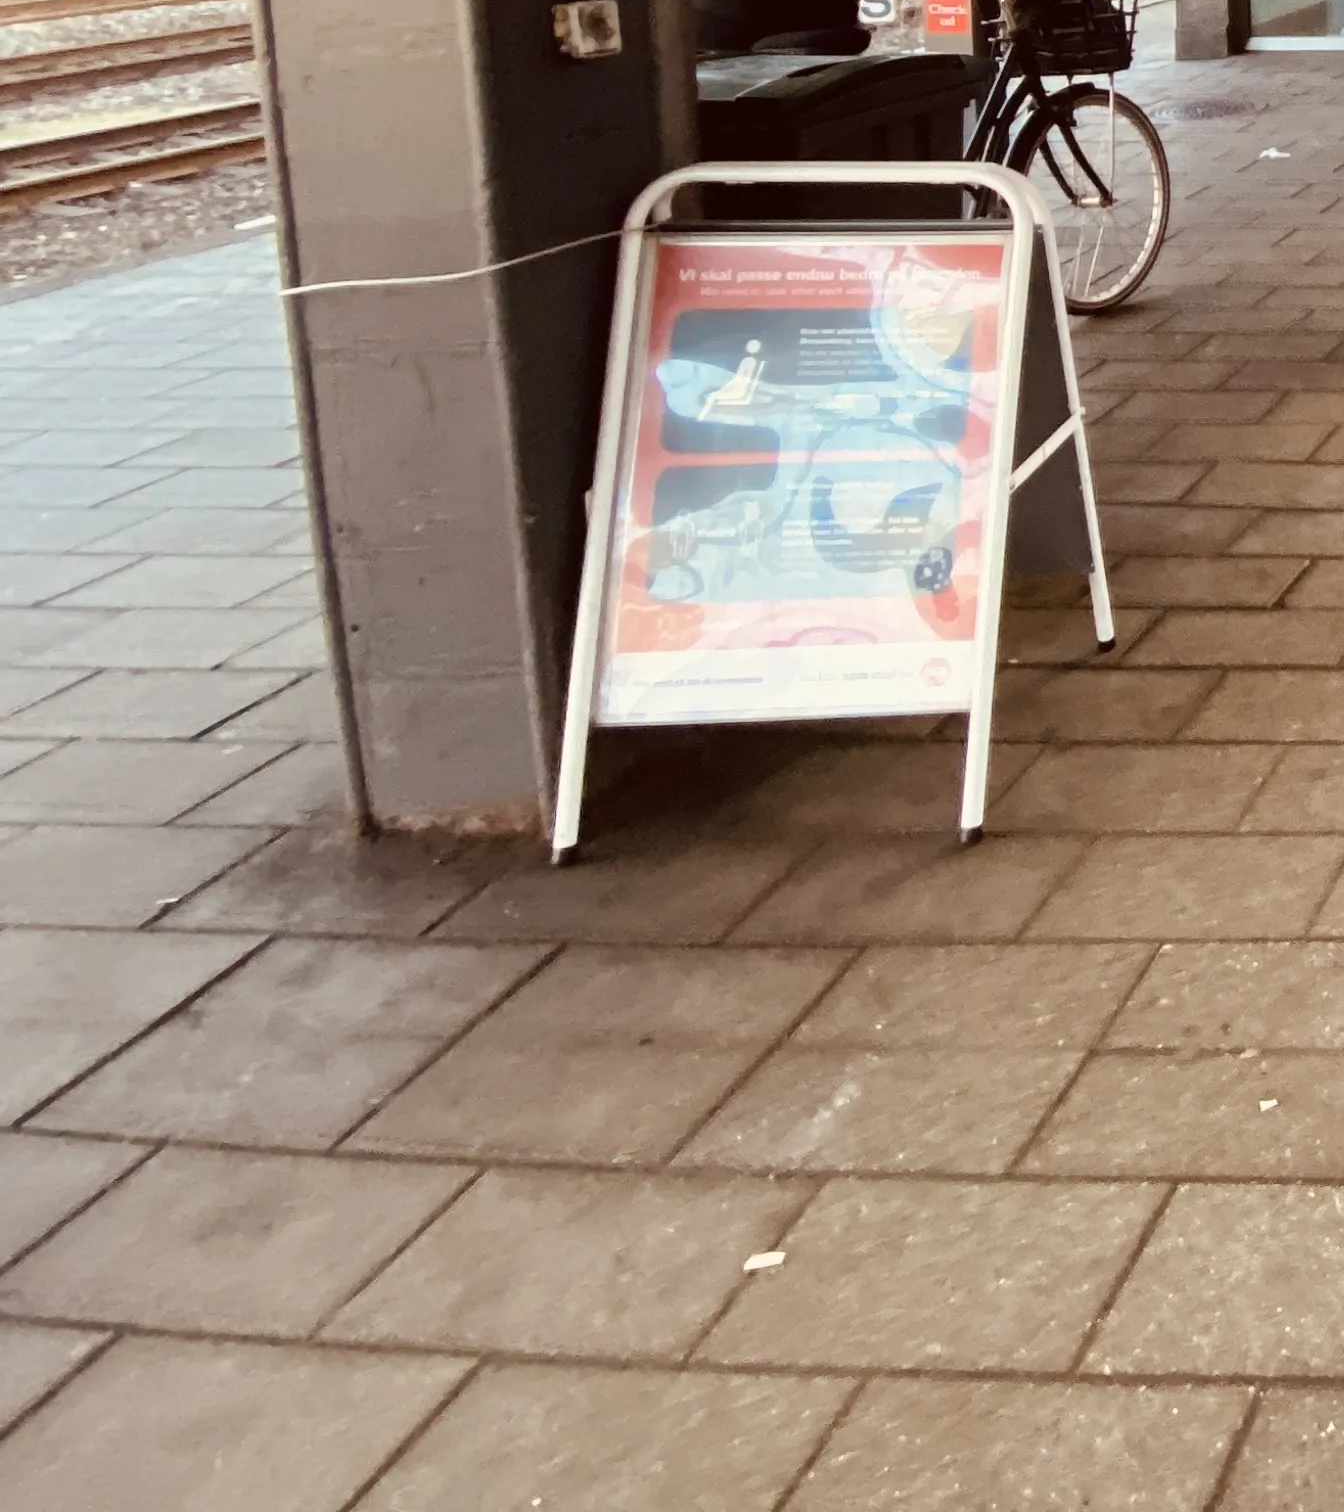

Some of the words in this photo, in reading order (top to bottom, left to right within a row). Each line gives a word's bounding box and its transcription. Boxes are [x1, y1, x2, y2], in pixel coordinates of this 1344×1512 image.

[928, 3, 967, 15] Check
[940, 15, 956, 27] ud
[700, 267, 733, 282] skal
